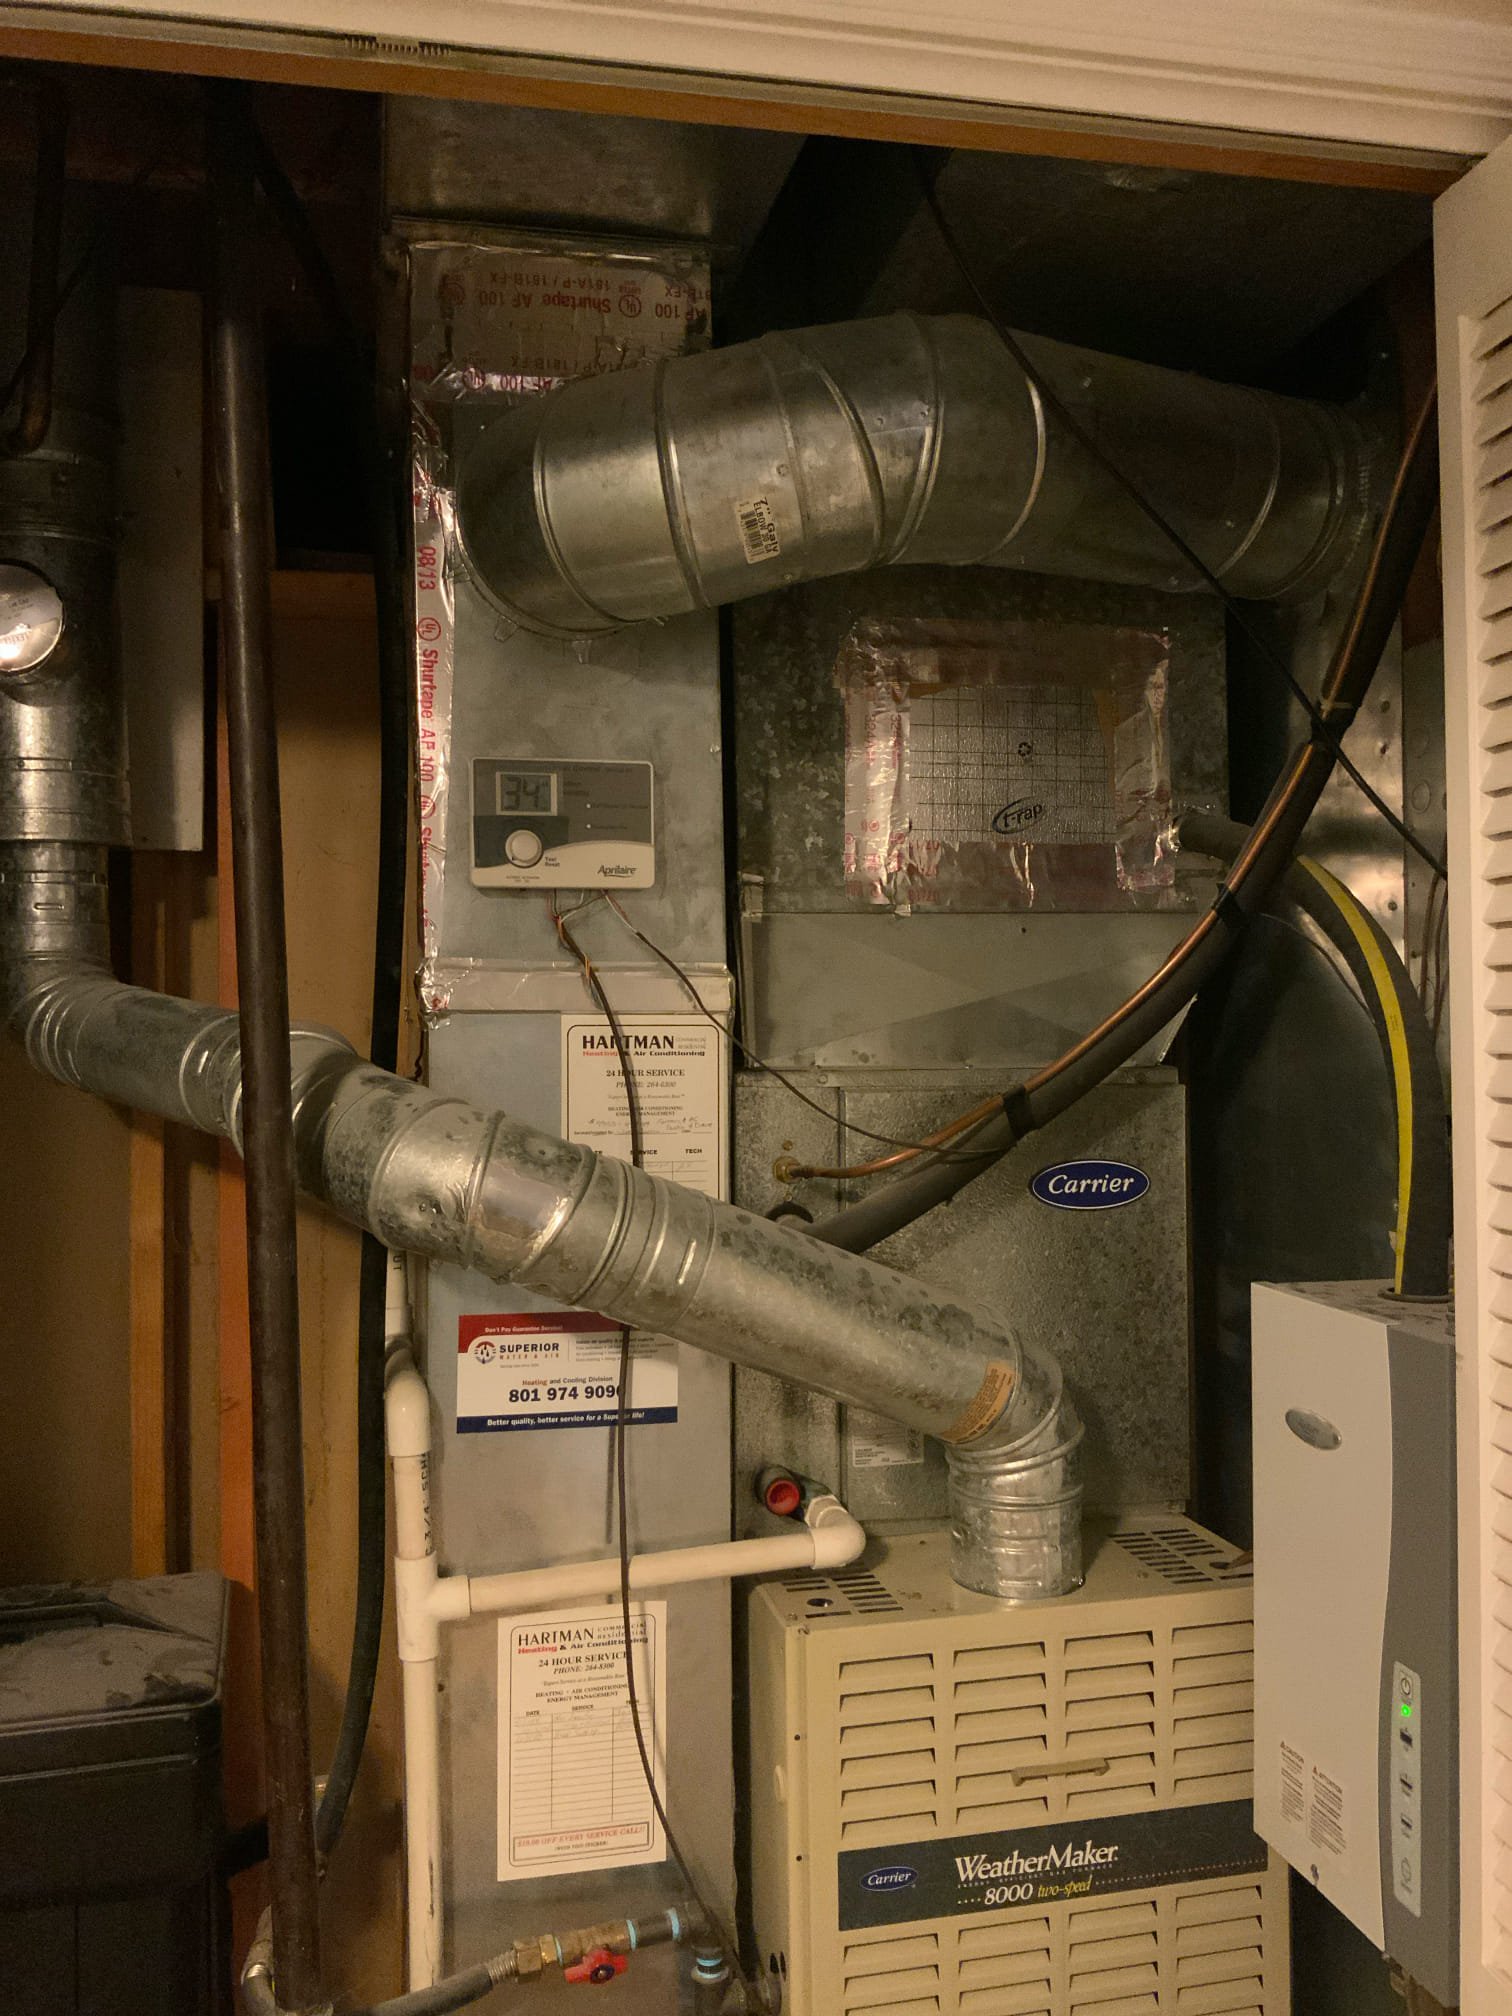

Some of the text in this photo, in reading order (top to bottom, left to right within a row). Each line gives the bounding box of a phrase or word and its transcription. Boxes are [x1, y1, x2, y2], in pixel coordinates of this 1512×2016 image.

[479, 290, 505, 305] 100
[511, 293, 533, 308] AF
[542, 291, 612, 314] Shurtape
[655, 303, 680, 318] 100
[500, 373, 524, 390] 100
[753, 500, 769, 531] ELBOW
[418, 547, 436, 590] 08/13
[420, 648, 439, 720] Shurtape
[420, 728, 436, 751] AF
[419, 755, 436, 782] 100
[503, 776, 541, 813] 34
[597, 864, 638, 877] Aprilaire
[606, 1069, 616, 1078] 24
[646, 1068, 685, 1078] SERVICE
[685, 1147, 703, 1155] TECH
[1047, 1173, 1135, 1195] Carrier
[499, 1342, 560, 1354] SUPERIOR
[550, 1377, 561, 1385] and
[563, 1376, 587, 1385] Cooling
[588, 1375, 613, 1383] Division
[508, 1388, 541, 1403] 801
[547, 1386, 579, 1401] 974
[487, 1418, 509, 1427] Better
[511, 1416, 536, 1427] quality,
[537, 1415, 559, 1424] better
[560, 1414, 584, 1422] service
[518, 1628, 594, 1647] HARTMAN
[538, 1659, 549, 1668] 24
[551, 1655, 582, 1666] HOUR
[585, 1828, 618, 1840] SERVICE
[867, 1871, 912, 1886] Carrier
[984, 1874, 1093, 1906] 8000 two-speed
